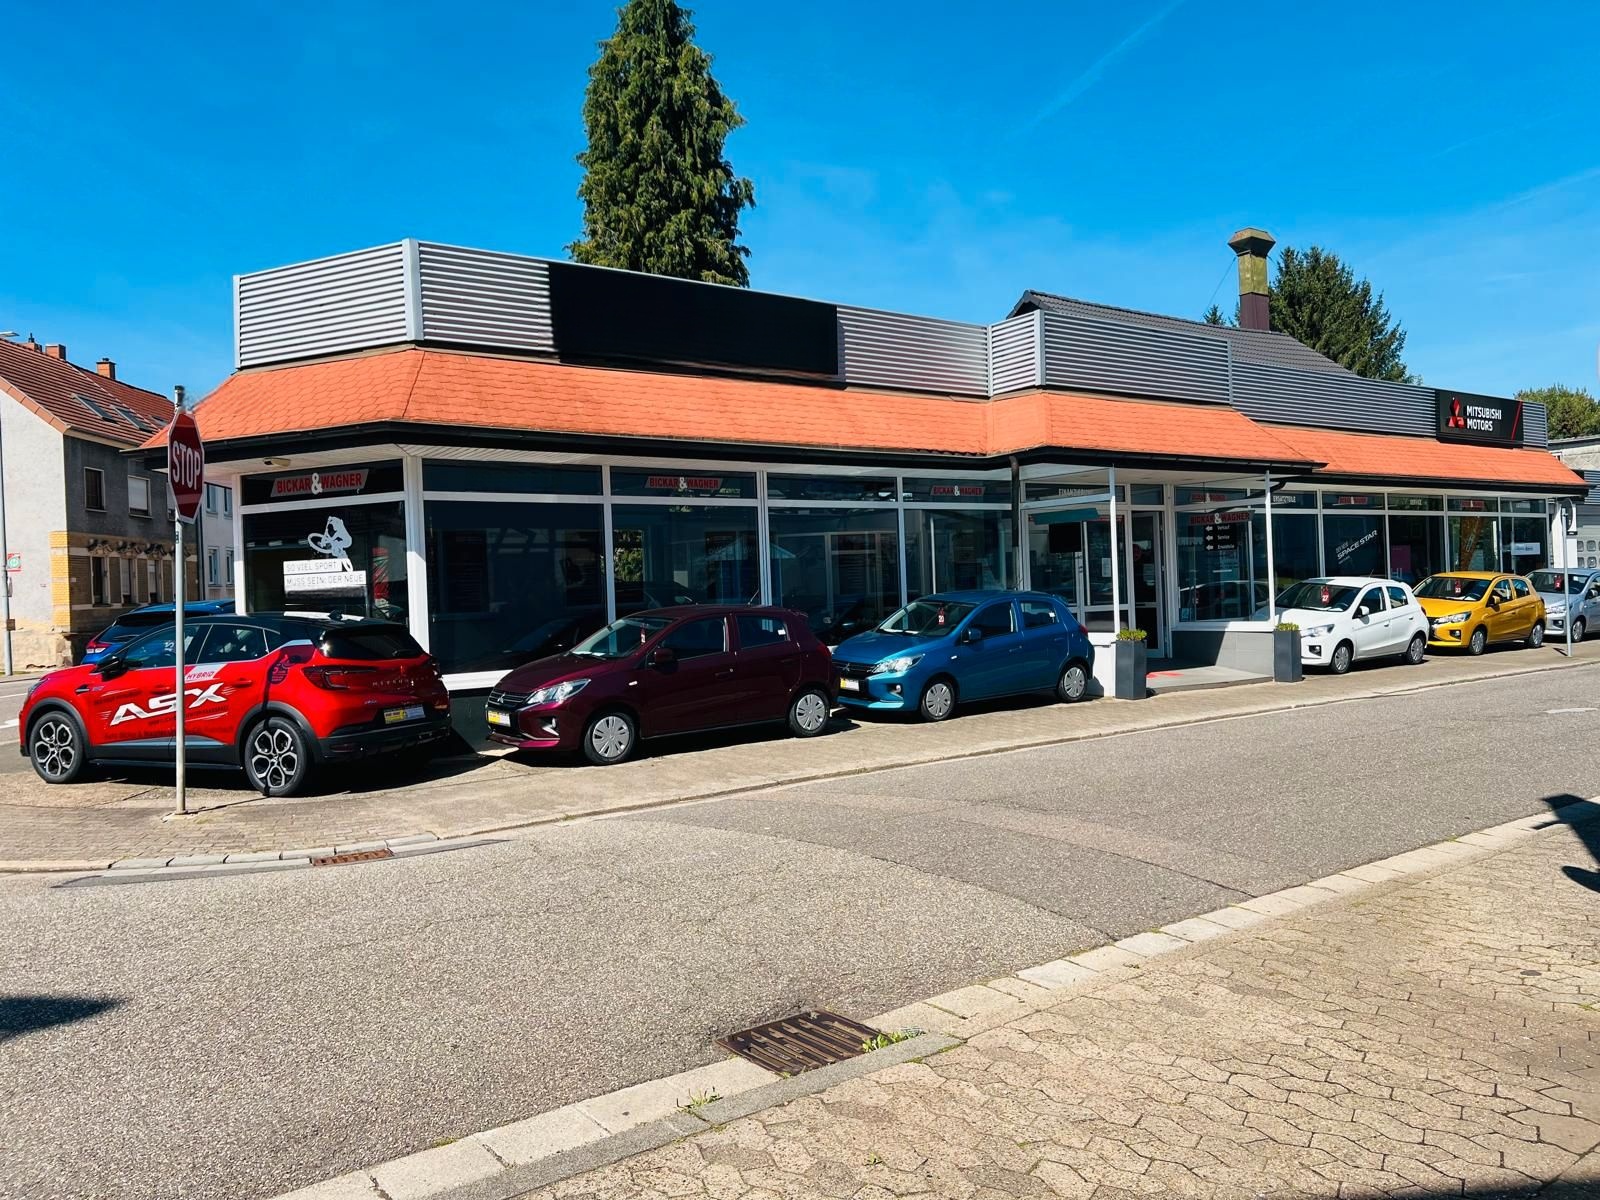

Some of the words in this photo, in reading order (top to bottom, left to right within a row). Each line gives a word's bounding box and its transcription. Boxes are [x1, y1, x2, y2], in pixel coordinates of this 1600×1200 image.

[1466, 405, 1502, 420] MITSUBISHI
[1467, 418, 1493, 431] MOTORS
[172, 440, 201, 491] STOP
[1337, 541, 1360, 560] SPACE
[1360, 530, 1378, 545] STAR
[297, 563, 313, 571] VIEL
[315, 561, 337, 570] SPORT
[286, 577, 305, 586] MUSS
[328, 575, 342, 584] DER
[344, 574, 364, 583] NEUE
[186, 671, 214, 680] HYBRID
[110, 682, 228, 726] ASX
